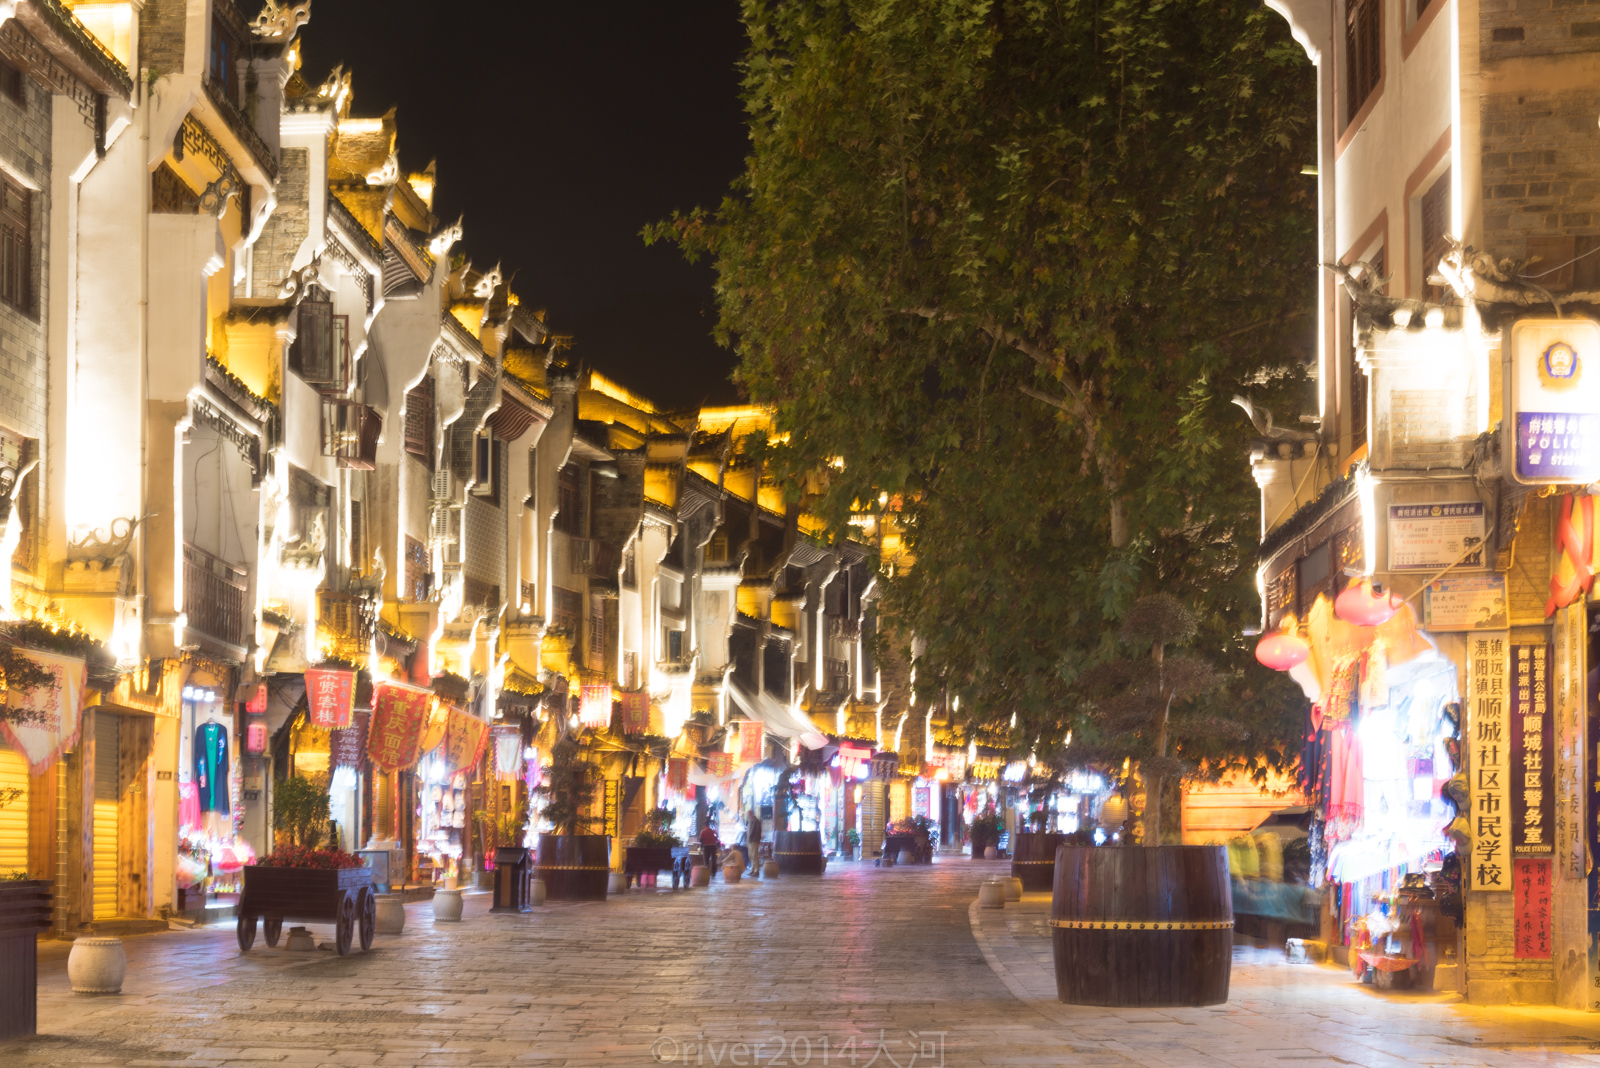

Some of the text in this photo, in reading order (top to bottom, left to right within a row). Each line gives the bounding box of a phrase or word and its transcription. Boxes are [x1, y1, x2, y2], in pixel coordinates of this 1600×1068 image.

[387, 688, 417, 702] 正宗
[1490, 639, 1503, 695] 镇远县
[1533, 648, 1546, 714] 镇远县公安局
[379, 699, 412, 766] 重庆面馆
[629, 696, 643, 722] 住宿
[1476, 697, 1503, 886] 顺城社区市民学校
[1523, 715, 1543, 844] 顺城社区警务室
[1515, 845, 1552, 853] POLICE STATION
